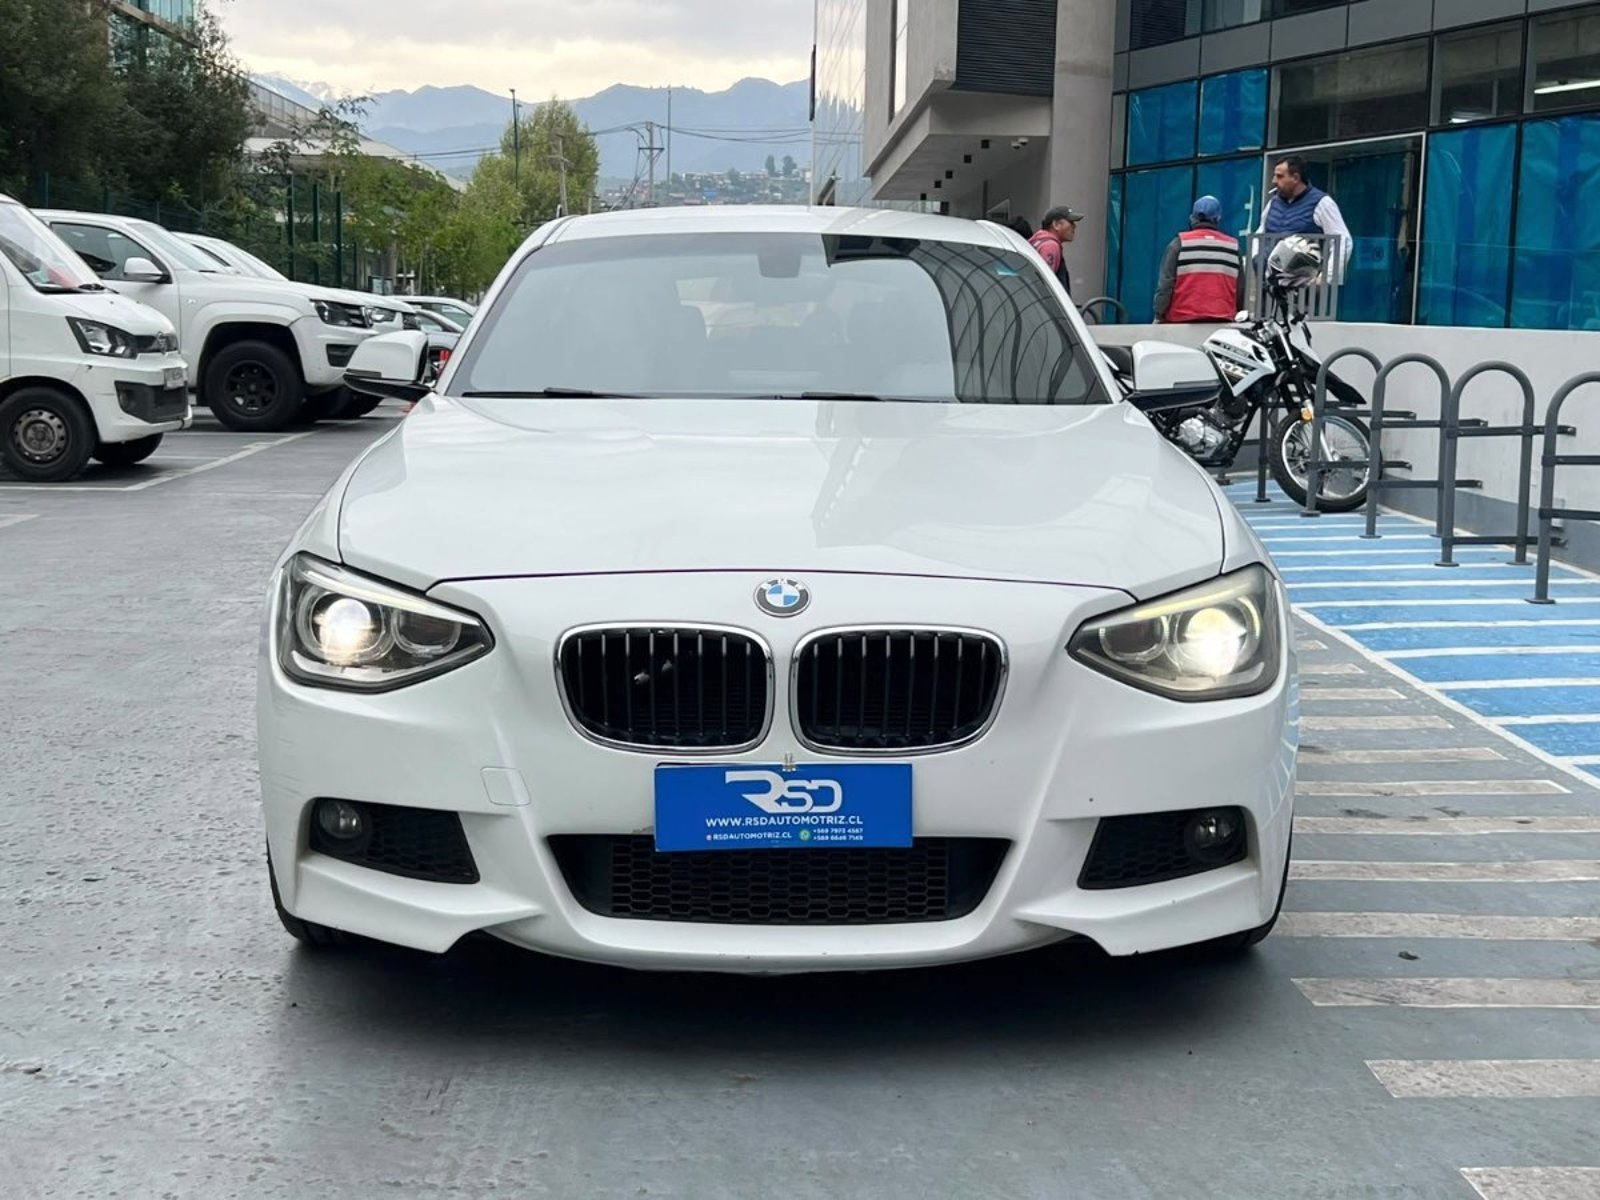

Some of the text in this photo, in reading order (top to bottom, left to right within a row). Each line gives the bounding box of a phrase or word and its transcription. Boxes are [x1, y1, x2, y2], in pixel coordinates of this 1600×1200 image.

[725, 770, 843, 814] RSD
[705, 815, 864, 828] WWW.RSDAUTOMOTRIZ.CL
[712, 831, 792, 841] RSDAUTOMOTRIZ.CL
